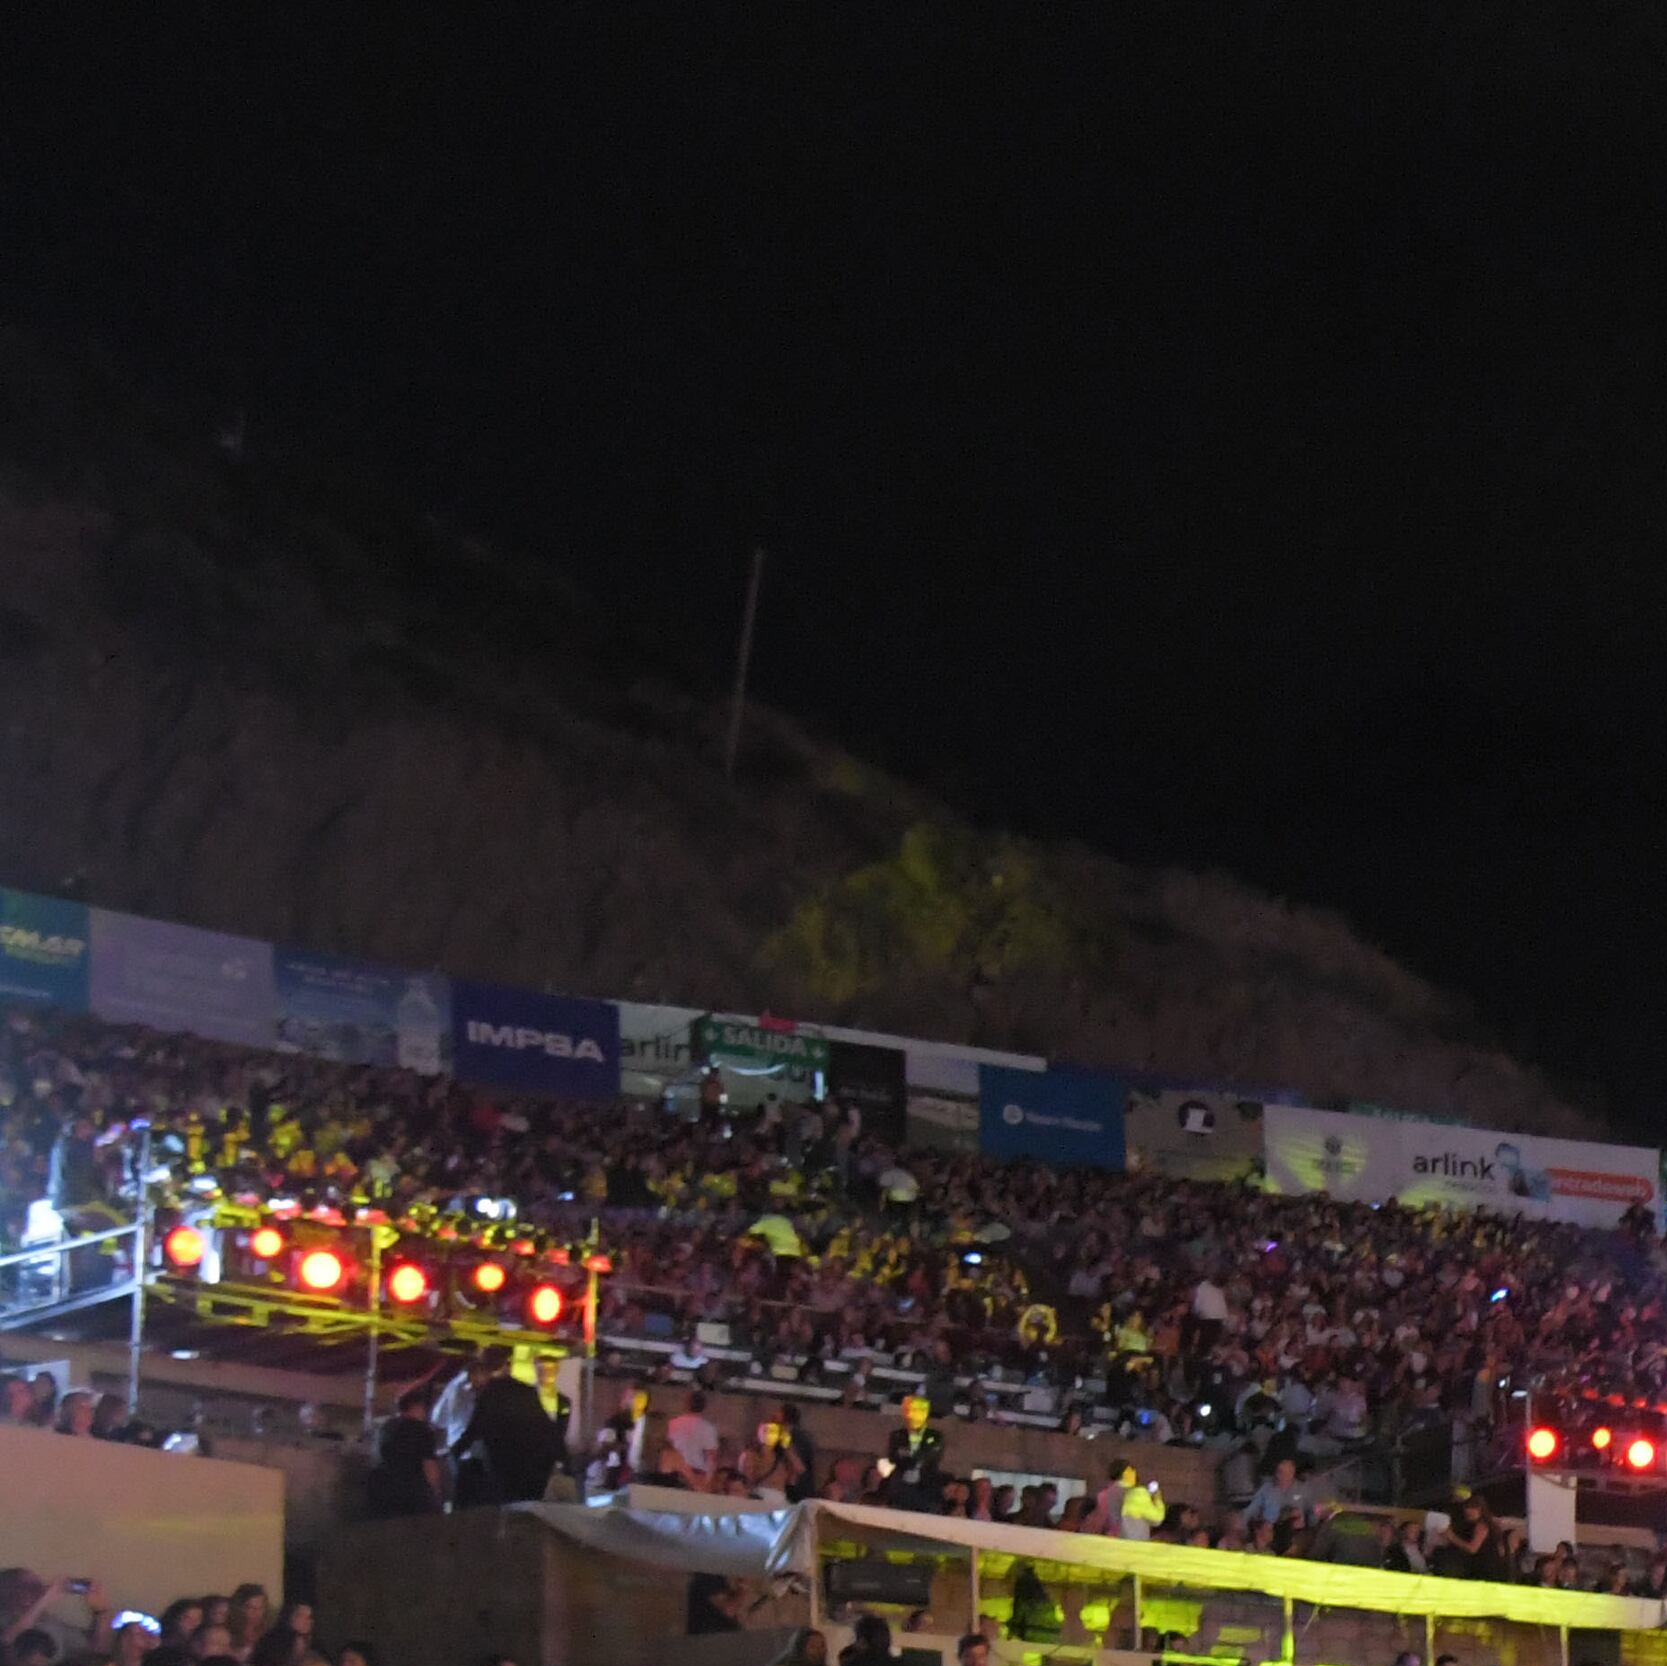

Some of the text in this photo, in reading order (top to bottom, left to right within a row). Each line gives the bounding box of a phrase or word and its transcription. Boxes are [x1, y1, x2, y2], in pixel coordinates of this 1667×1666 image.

[466, 1020, 605, 1064] IMPSA
[723, 1025, 807, 1058] SALIDA
[1413, 1152, 1495, 1181] arlink
